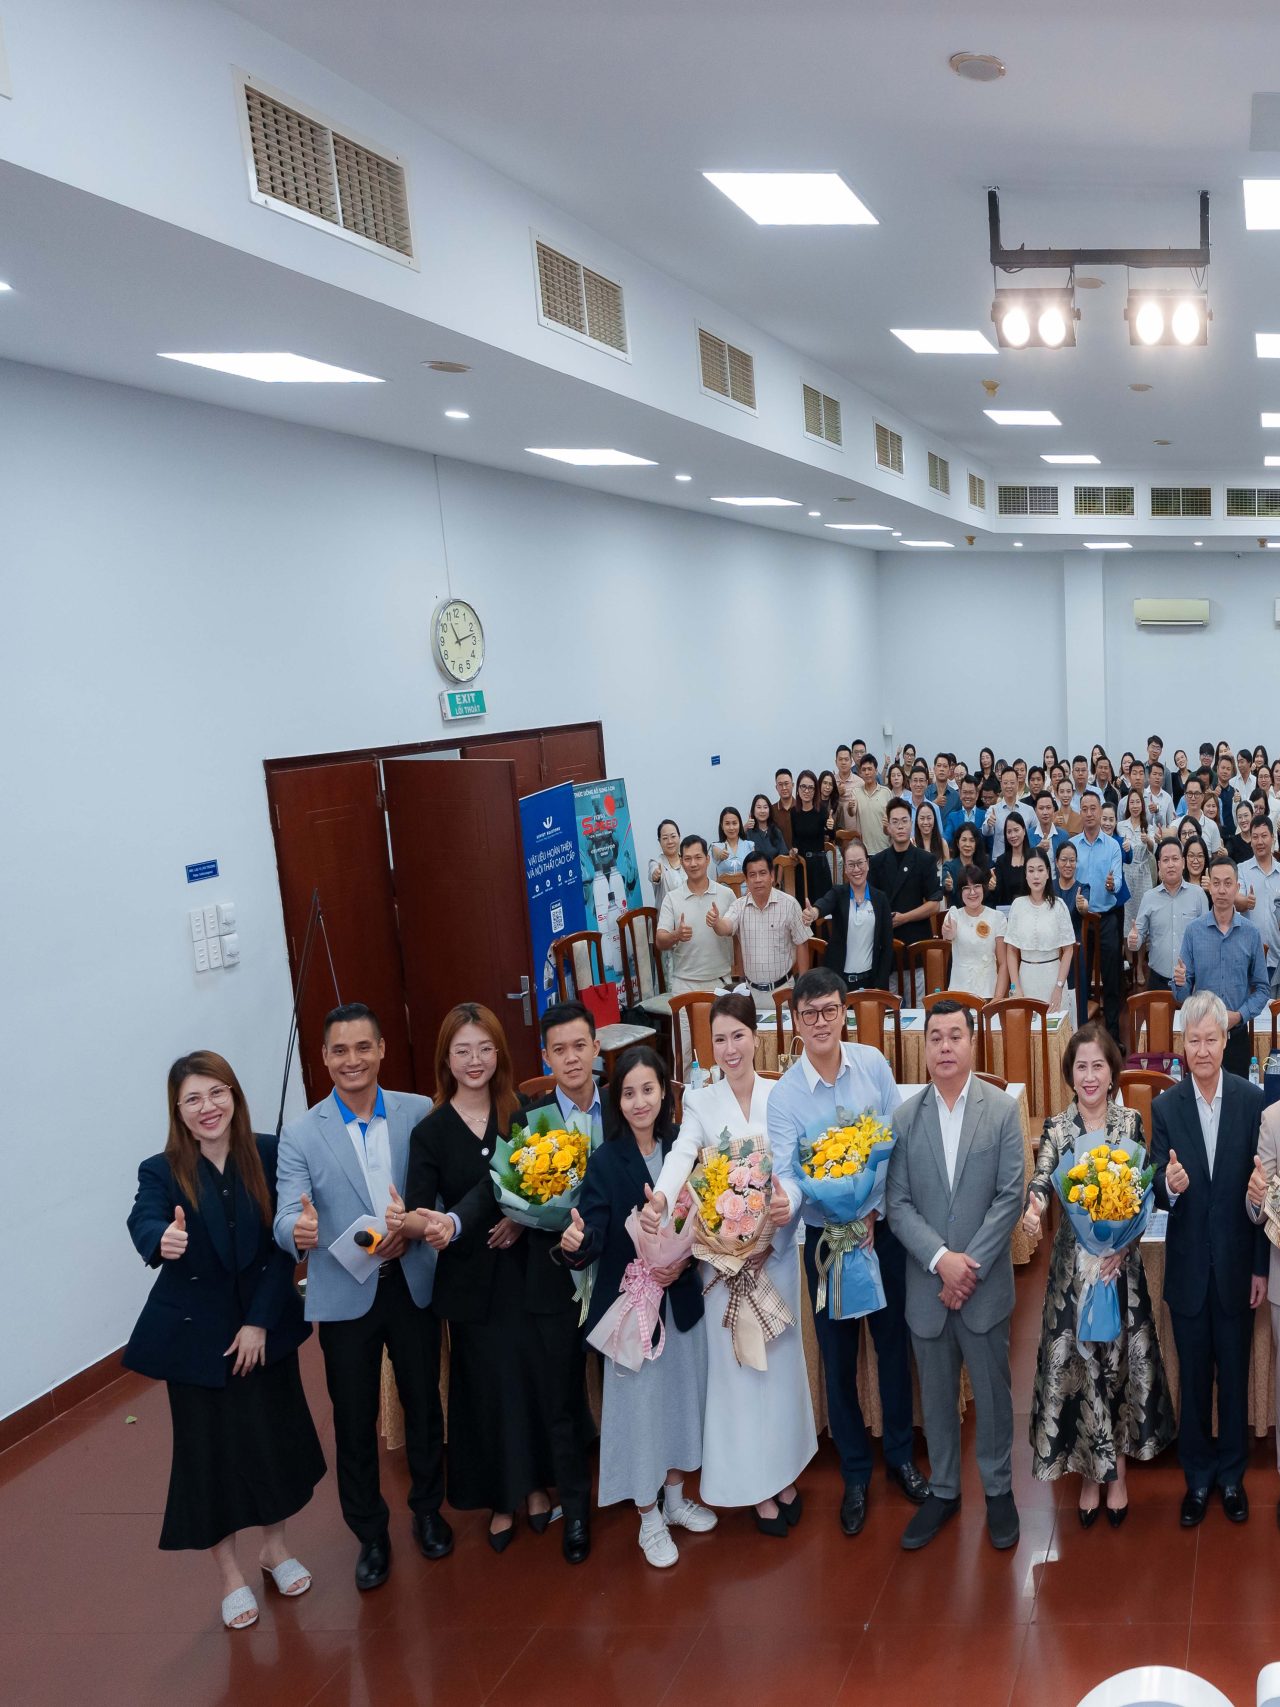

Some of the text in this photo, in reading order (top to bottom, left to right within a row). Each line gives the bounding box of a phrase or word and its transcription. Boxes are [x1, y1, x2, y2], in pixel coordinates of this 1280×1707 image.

[446, 612, 452, 622] 11
[452, 608, 460, 618] 12
[440, 623, 448, 633] 10
[469, 622, 474, 632] 2
[440, 636, 445, 646] 9
[472, 636, 477, 646] 3
[444, 650, 449, 660] 8
[470, 650, 475, 659] 4
[451, 660, 456, 670] 7
[458, 664, 464, 673] 6
[466, 660, 471, 670] 5
[456, 693, 476, 704] EXIT
[464, 704, 480, 714] THOÁT
[528, 840, 573, 866] VẬT LIỆU HOÀN THIỆN
[527, 850, 575, 880] VÀ NỘI THẤT CAO CẤP
